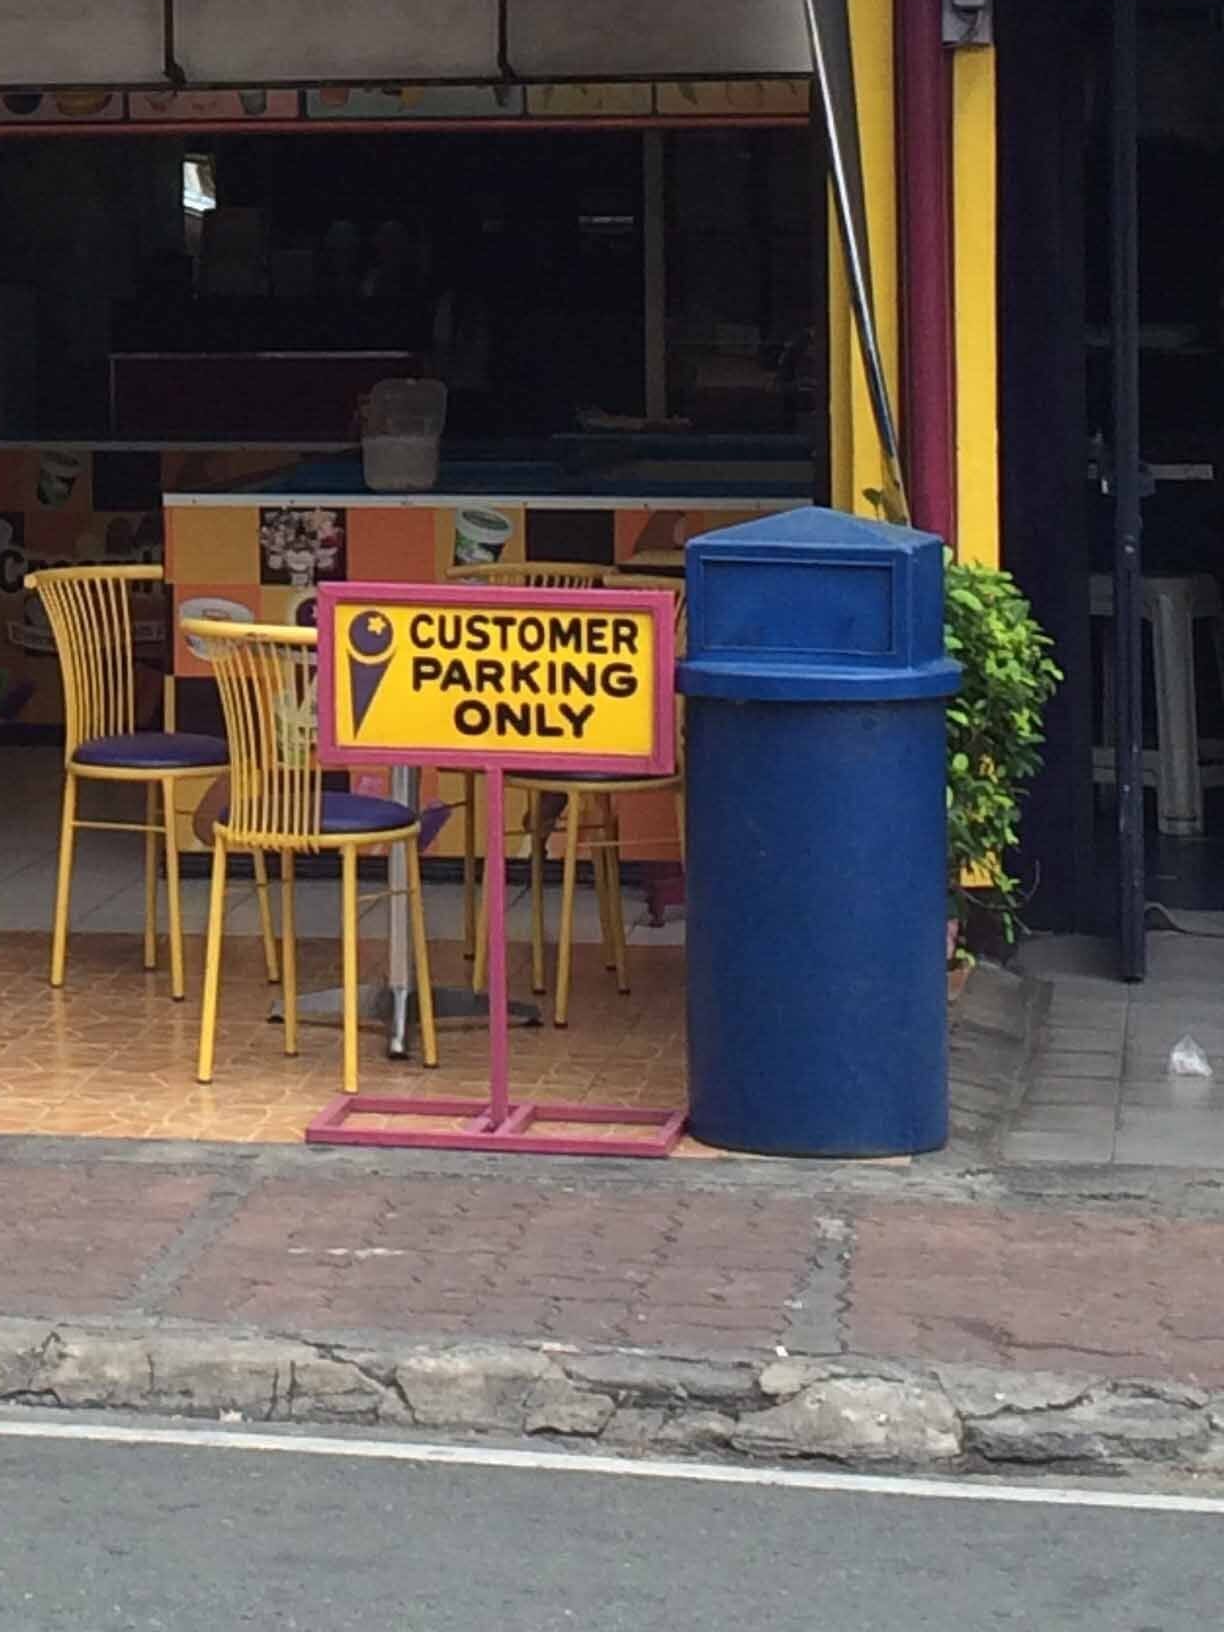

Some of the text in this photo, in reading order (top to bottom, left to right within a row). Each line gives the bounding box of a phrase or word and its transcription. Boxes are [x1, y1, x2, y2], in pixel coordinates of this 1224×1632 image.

[409, 614, 639, 655] CUSTOMER
[412, 656, 638, 697] PARKING
[454, 699, 595, 738] ONLY
